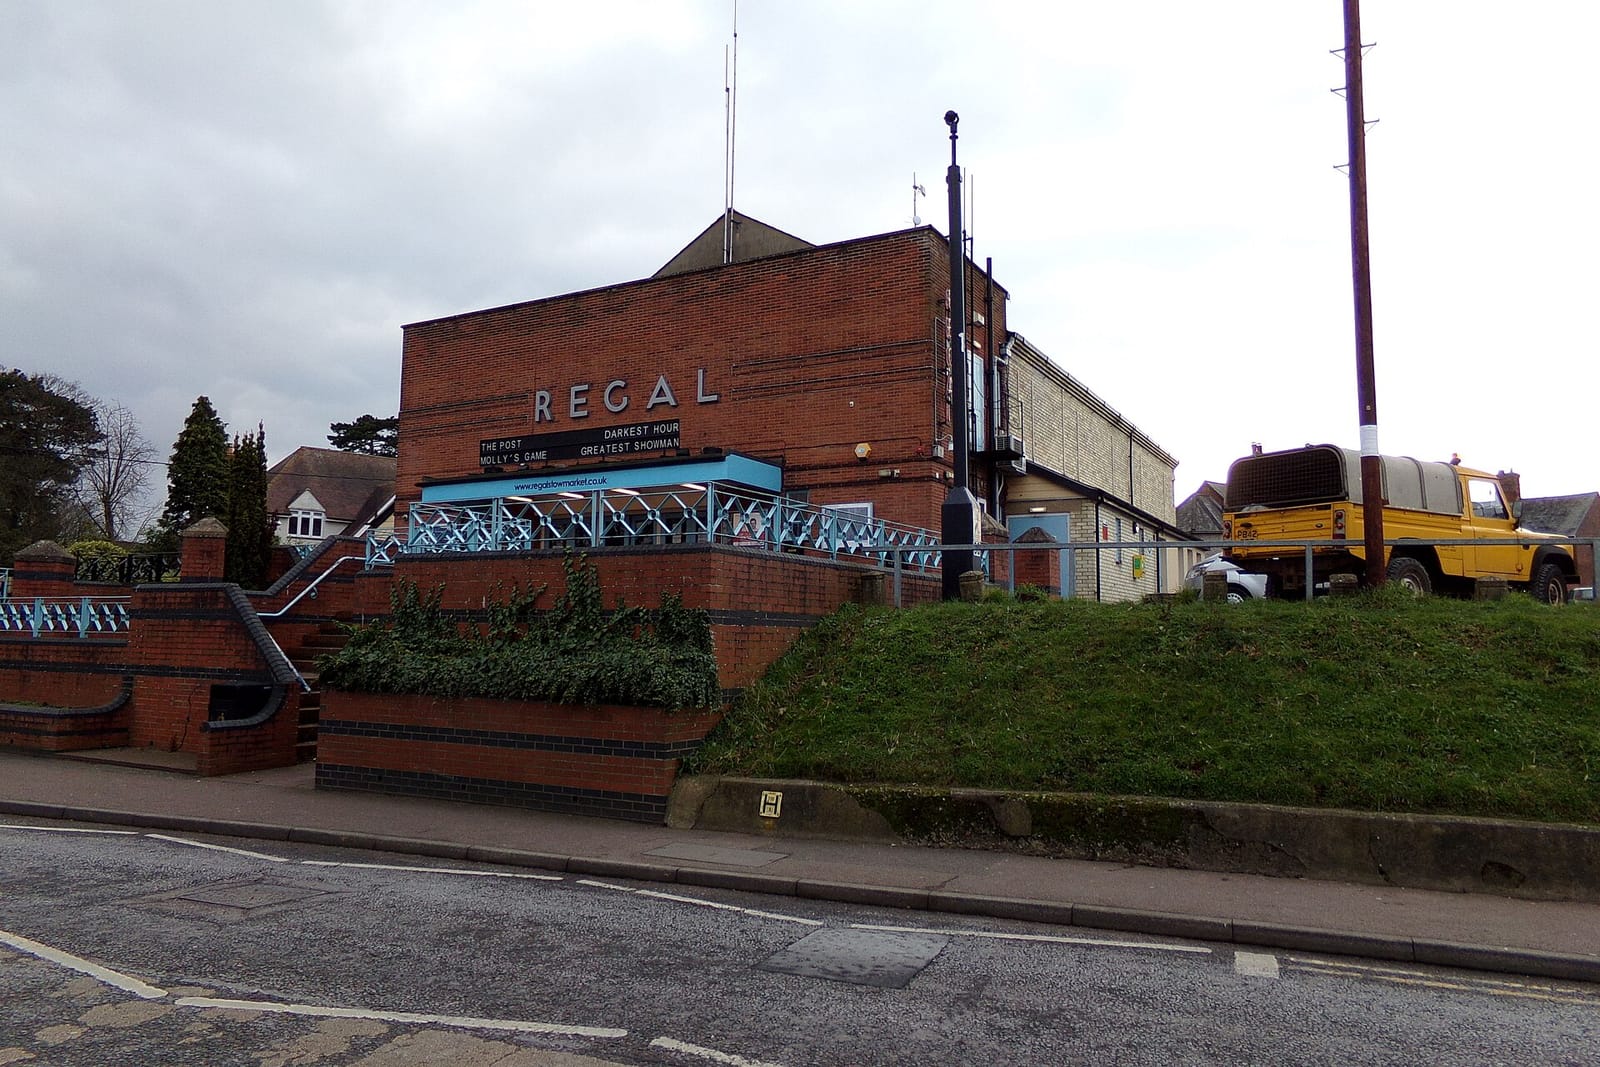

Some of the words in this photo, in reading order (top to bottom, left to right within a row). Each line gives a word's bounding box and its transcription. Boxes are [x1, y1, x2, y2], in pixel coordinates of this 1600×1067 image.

[534, 367, 718, 422] REGAL
[604, 425, 648, 439] DARKEST
[653, 422, 679, 434] HOUR
[481, 442, 497, 452] THE
[499, 439, 522, 450] POST
[580, 442, 630, 456] GREATEST
[634, 437, 679, 450] SHOWMAN
[480, 453, 520, 465] MOLLY'S
[524, 450, 548, 461] GAME
[514, 476, 607, 491] www.regalstowmarket.co.uk
[762, 793, 779, 815] H
